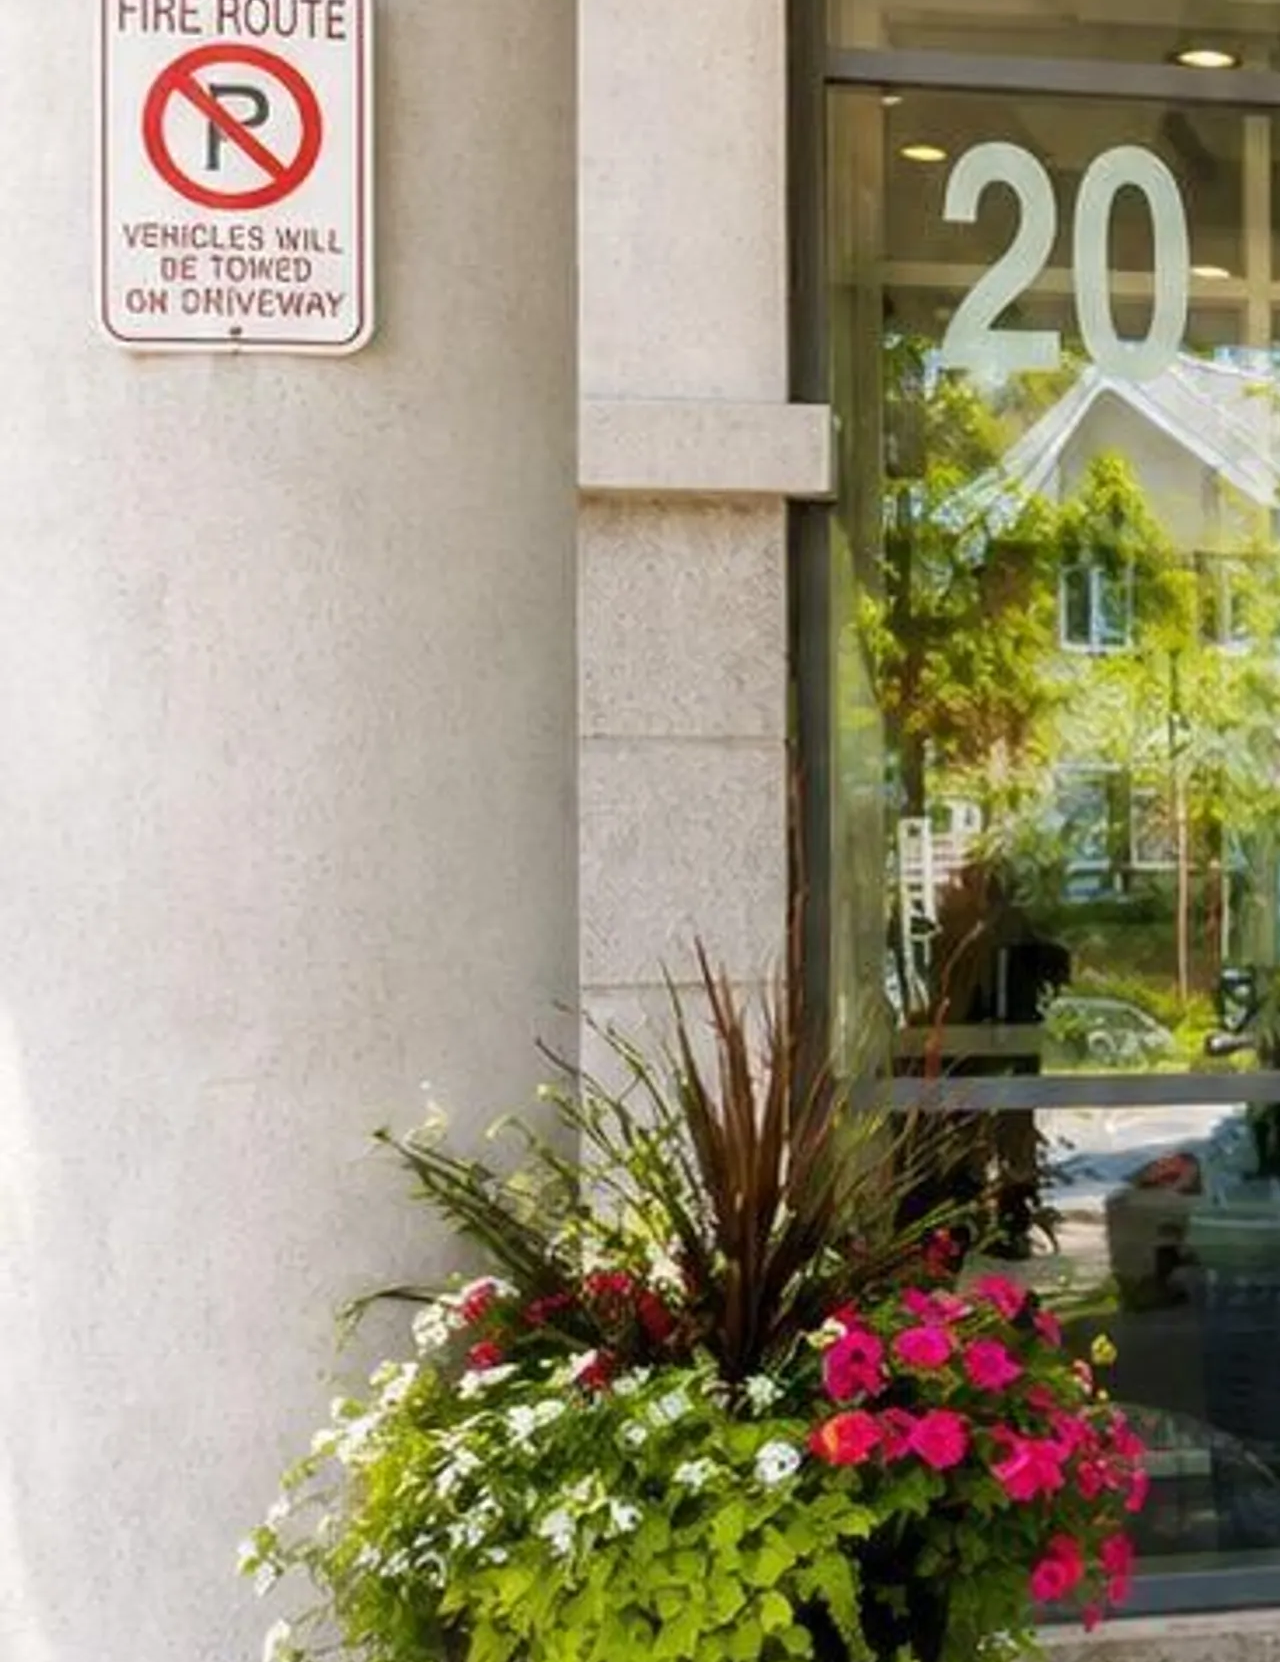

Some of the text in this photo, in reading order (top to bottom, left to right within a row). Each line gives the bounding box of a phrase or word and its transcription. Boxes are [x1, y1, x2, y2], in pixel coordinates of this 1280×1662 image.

[122, 223, 344, 255] VEHICLES WILL
[160, 256, 312, 283] BE TOWED
[941, 141, 1191, 377] 20
[125, 288, 346, 319] ON DRIVEWAY
